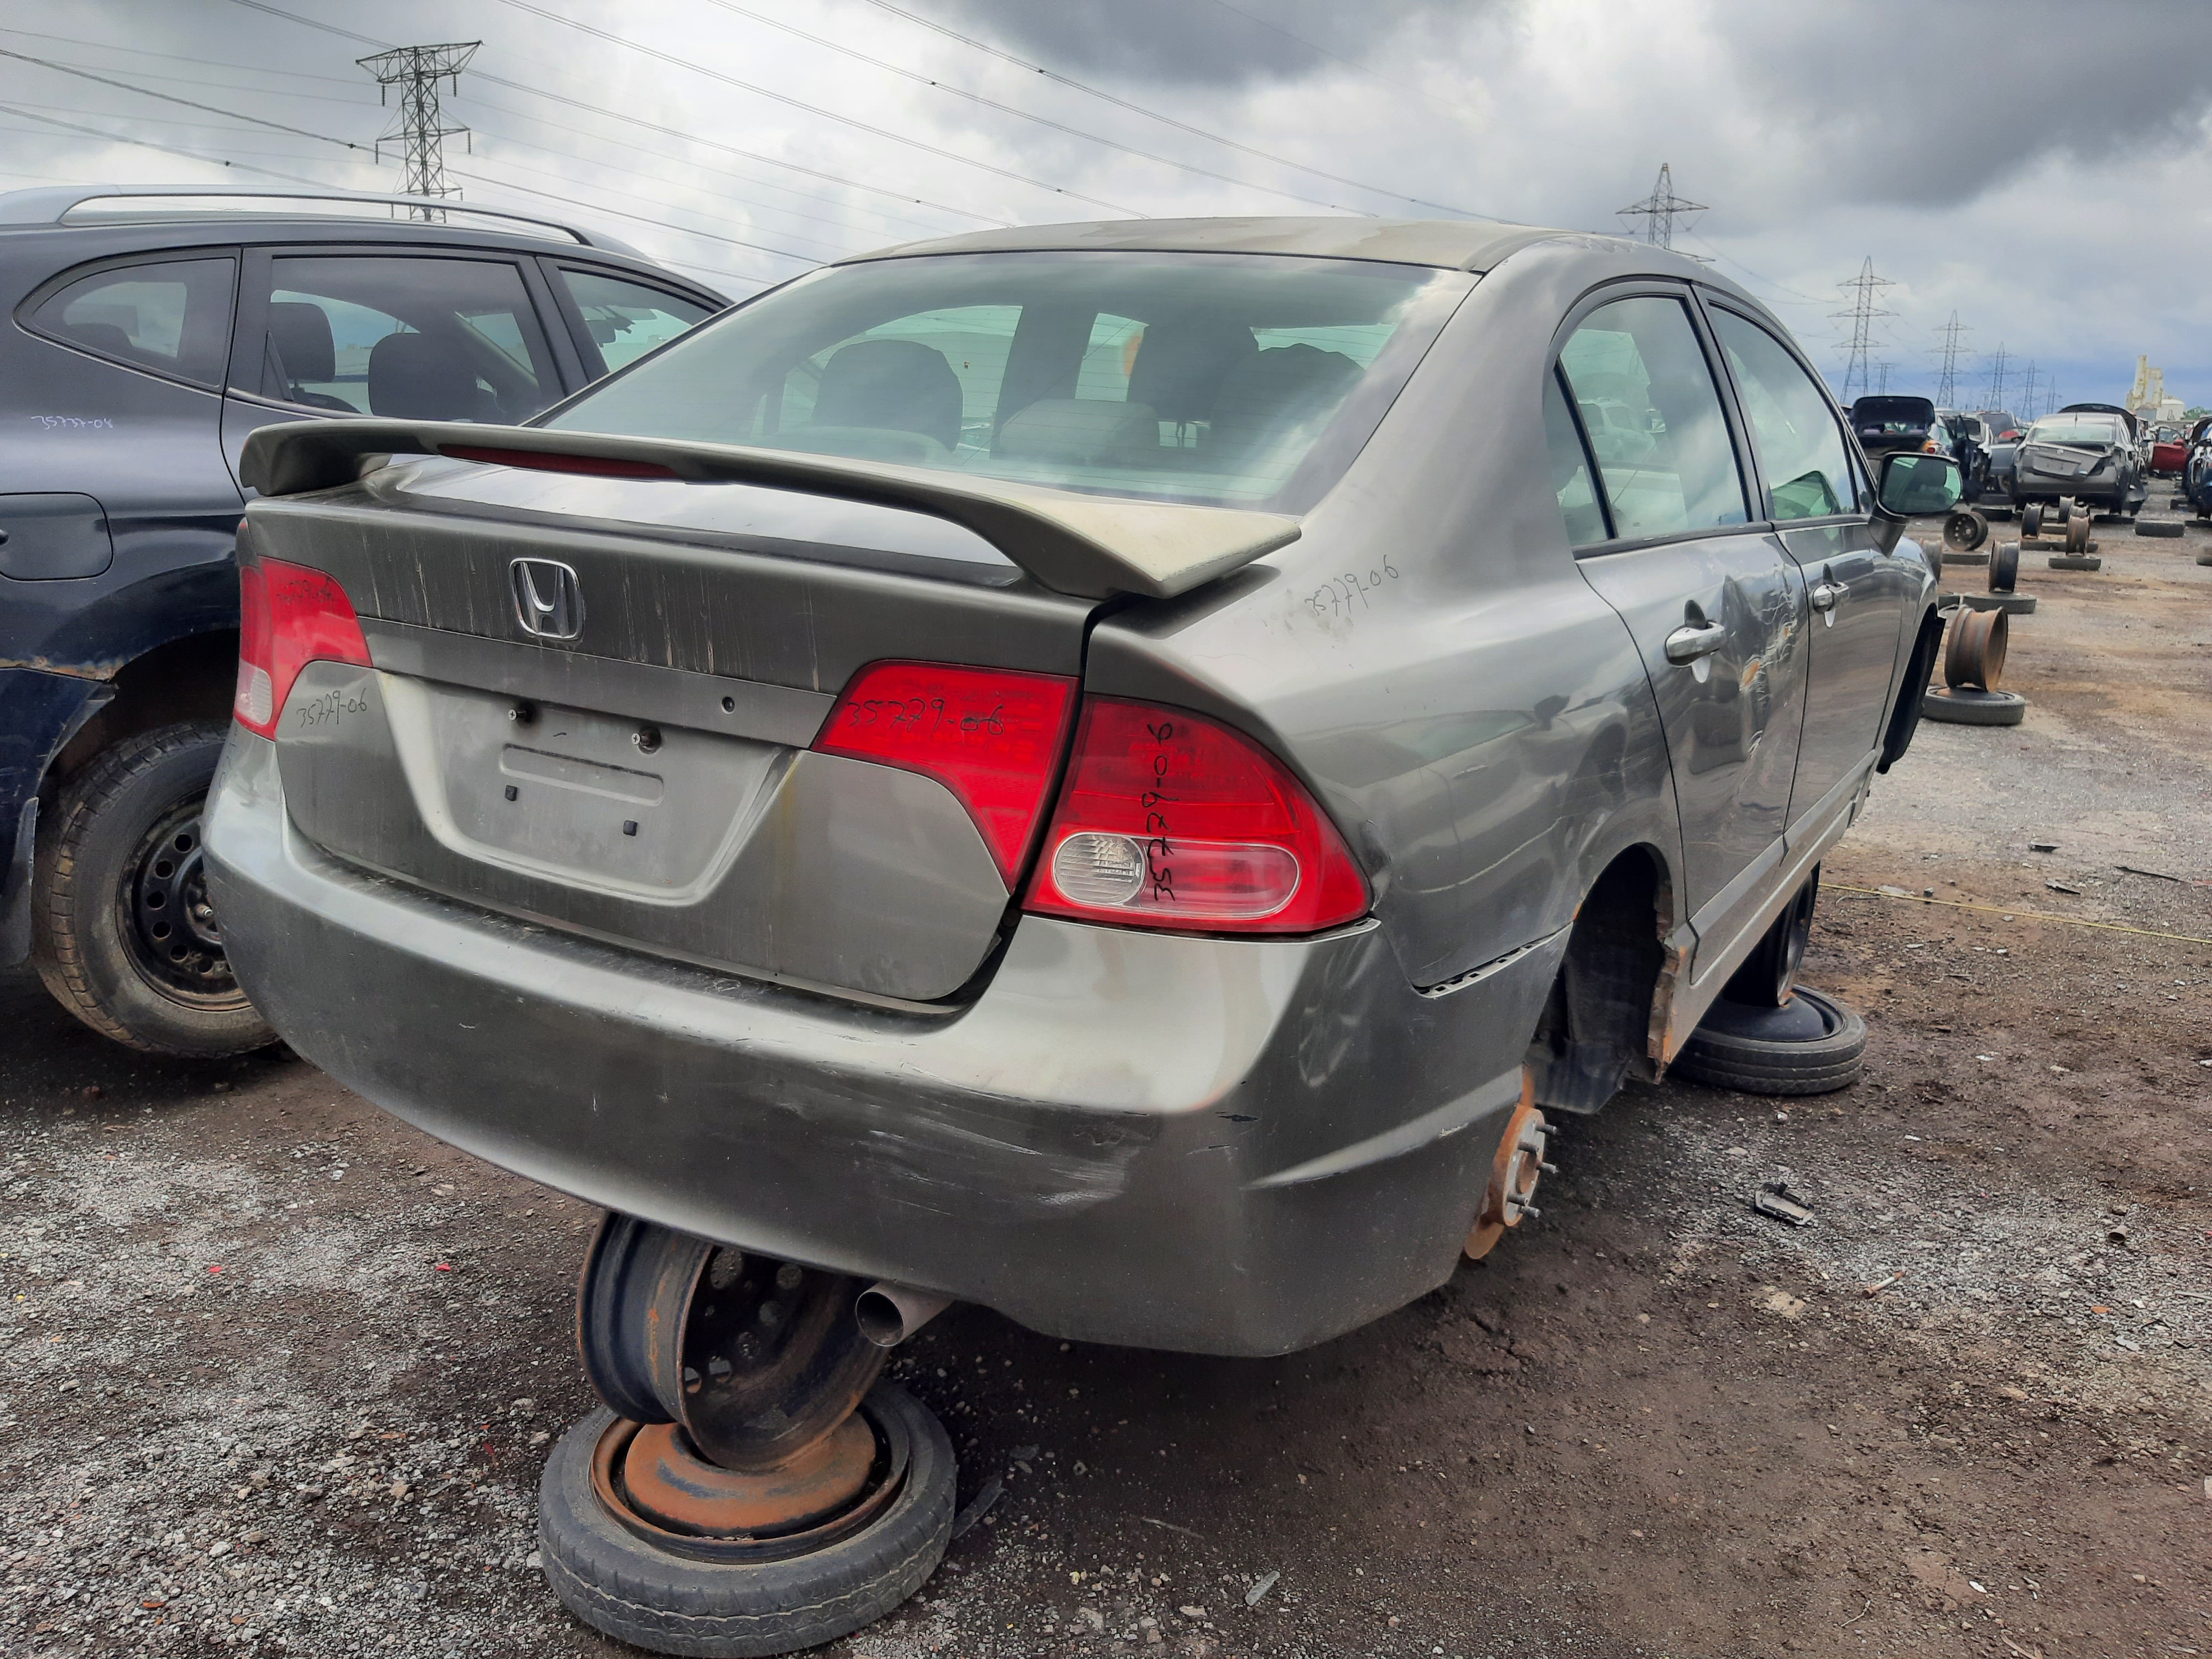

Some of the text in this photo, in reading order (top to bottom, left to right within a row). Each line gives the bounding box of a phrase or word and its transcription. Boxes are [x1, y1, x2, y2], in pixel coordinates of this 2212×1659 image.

[296, 687, 367, 728] 35779-06
[847, 697, 1004, 740] 35779-06
[1141, 722, 1181, 902] 35779-06
